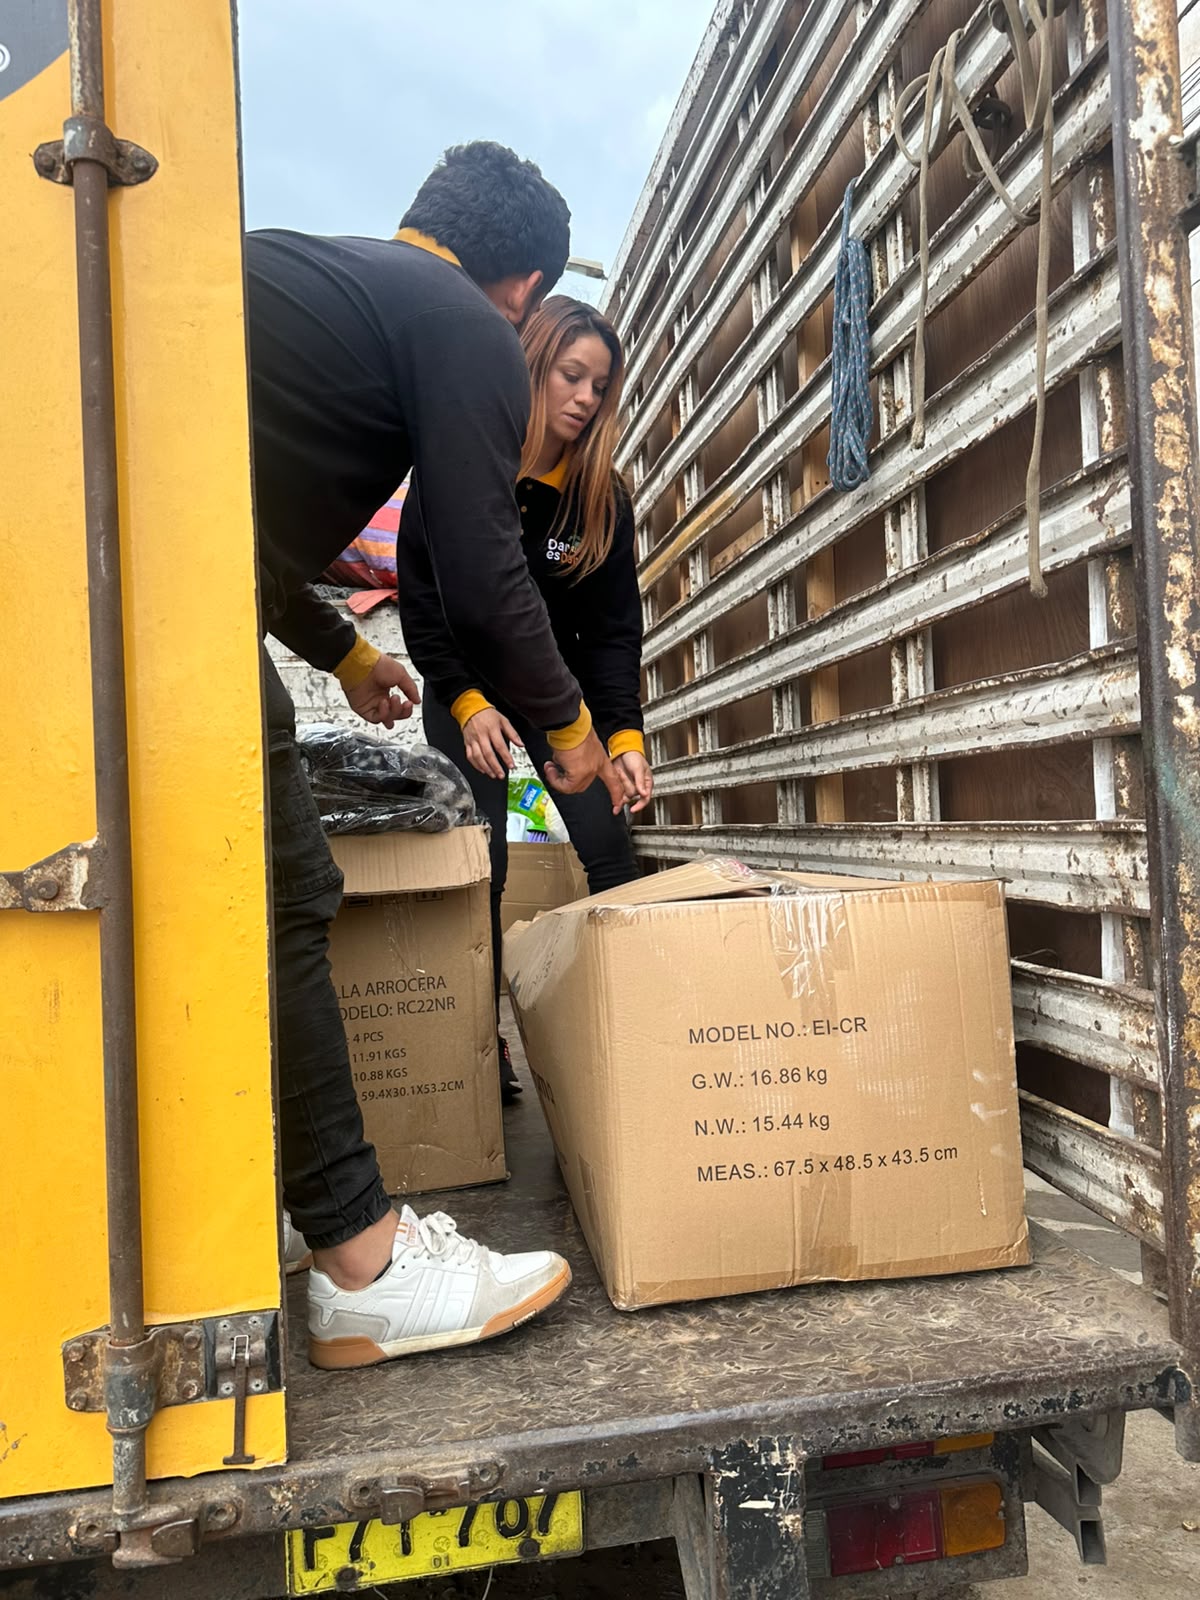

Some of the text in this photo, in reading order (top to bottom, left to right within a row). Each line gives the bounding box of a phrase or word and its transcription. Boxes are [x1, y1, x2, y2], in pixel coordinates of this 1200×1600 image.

[337, 975, 447, 999] LA ARROCERA
[397, 996, 456, 1016] RC22NR
[353, 1030, 384, 1044] 4 PCS
[689, 1016, 868, 1044] MODEL NO.: EI-CR
[352, 1047, 407, 1063] 11.91 KGS
[353, 1067, 408, 1082] 10.88 KGS
[691, 1066, 828, 1090] G.W.: 16.86 kg
[694, 1112, 831, 1136] N.W.: 15.44 kg
[697, 1145, 959, 1182] MEAS.: 67.5 x 48.5 x 43.5 cm
